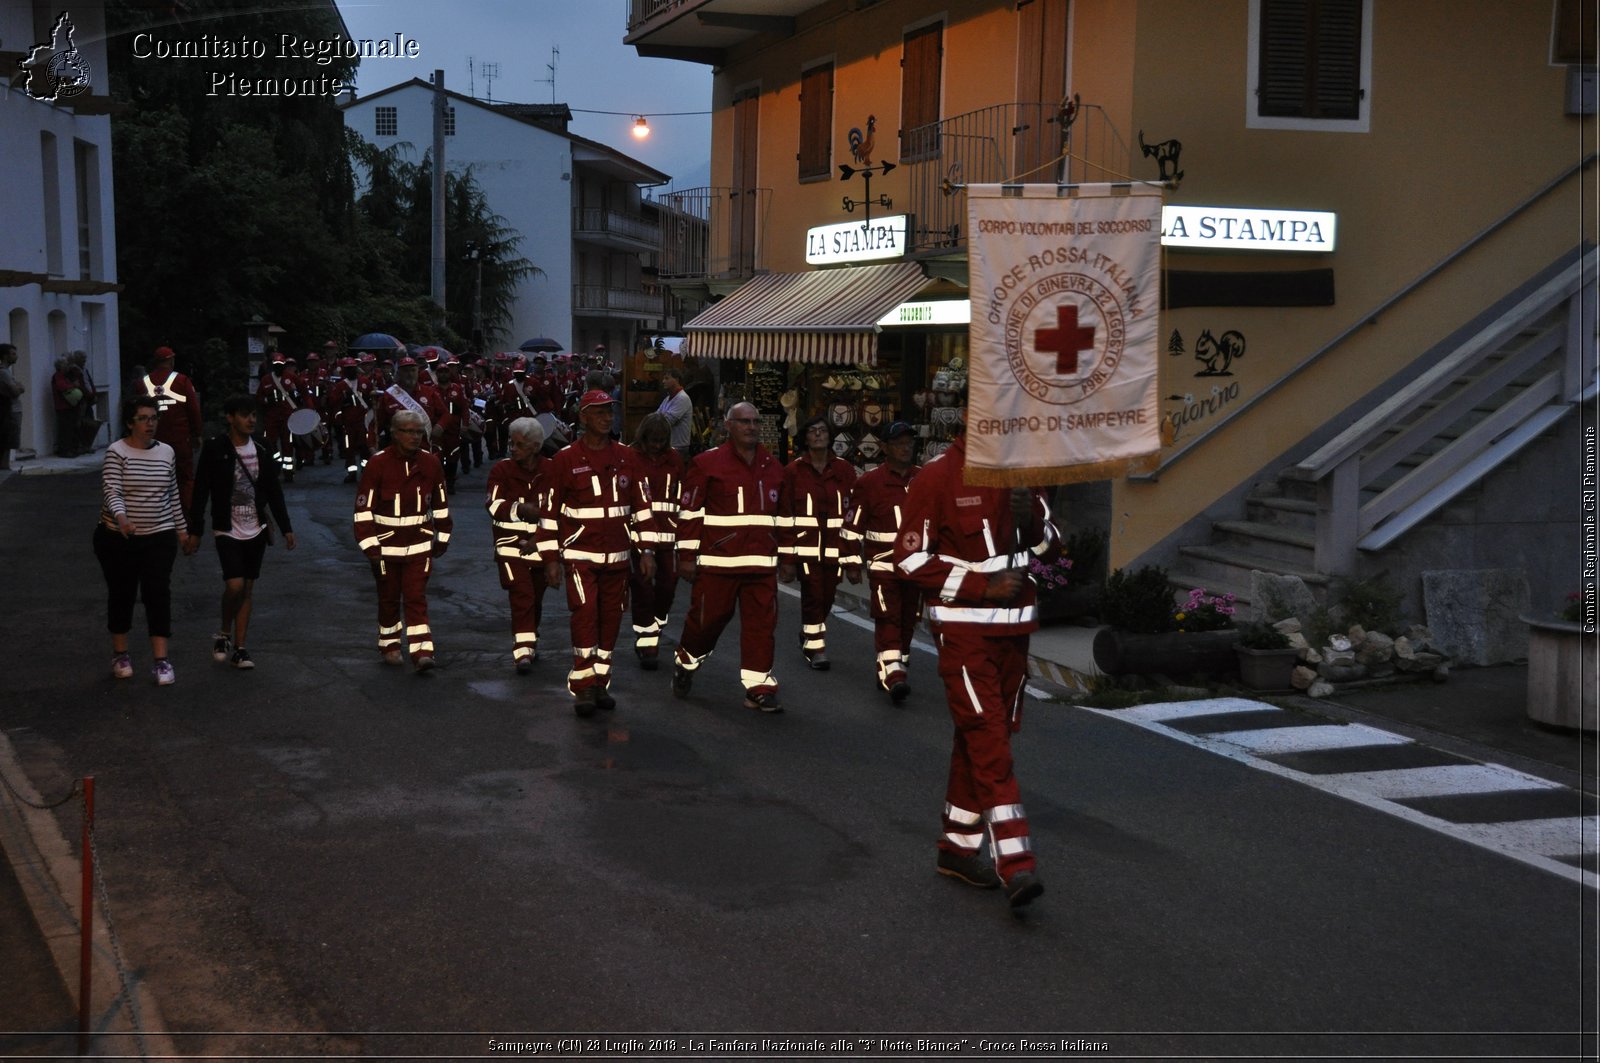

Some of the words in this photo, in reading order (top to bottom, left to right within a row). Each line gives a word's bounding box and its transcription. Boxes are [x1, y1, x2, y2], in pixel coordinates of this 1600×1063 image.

[809, 233, 826, 256] LA
[833, 225, 896, 254] STAMPA
[978, 219, 1016, 234] CORPO
[1020, 221, 1075, 236] VOLONTARI
[1077, 221, 1095, 235] DEL
[1097, 218, 1152, 234] SOCCORSO
[1199, 216, 1325, 243] STAMPA
[988, 264, 1027, 326] CROCE
[1028, 246, 1088, 272] ROSSA
[1092, 252, 1145, 320] ITALIANA
[1020, 291, 1037, 308] DI
[1037, 275, 1094, 297] GINEVRA
[1006, 308, 1049, 398] CONVENZIONE
[1104, 310, 1122, 369] AGOSTO
[976, 415, 1041, 436] GRUPPO
[1046, 415, 1062, 432] DI
[1066, 408, 1148, 430] SAMPEYRE
